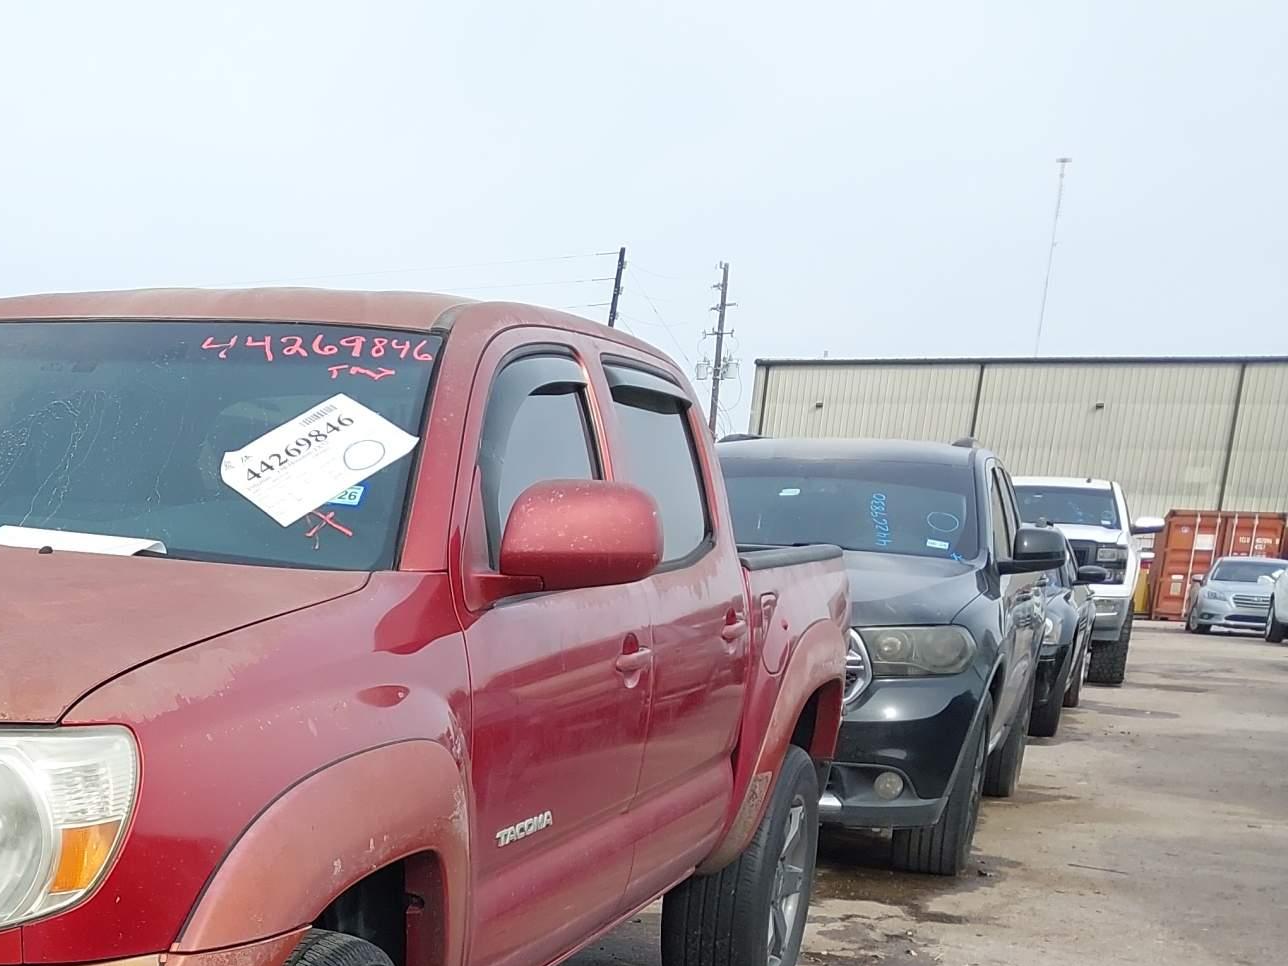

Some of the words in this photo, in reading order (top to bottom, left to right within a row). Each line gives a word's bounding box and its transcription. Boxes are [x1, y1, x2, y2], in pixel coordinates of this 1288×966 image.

[202, 335, 433, 361] 44269846
[246, 413, 355, 482] 44269846
[337, 489, 359, 501] 26
[495, 810, 553, 848] TACOMA
